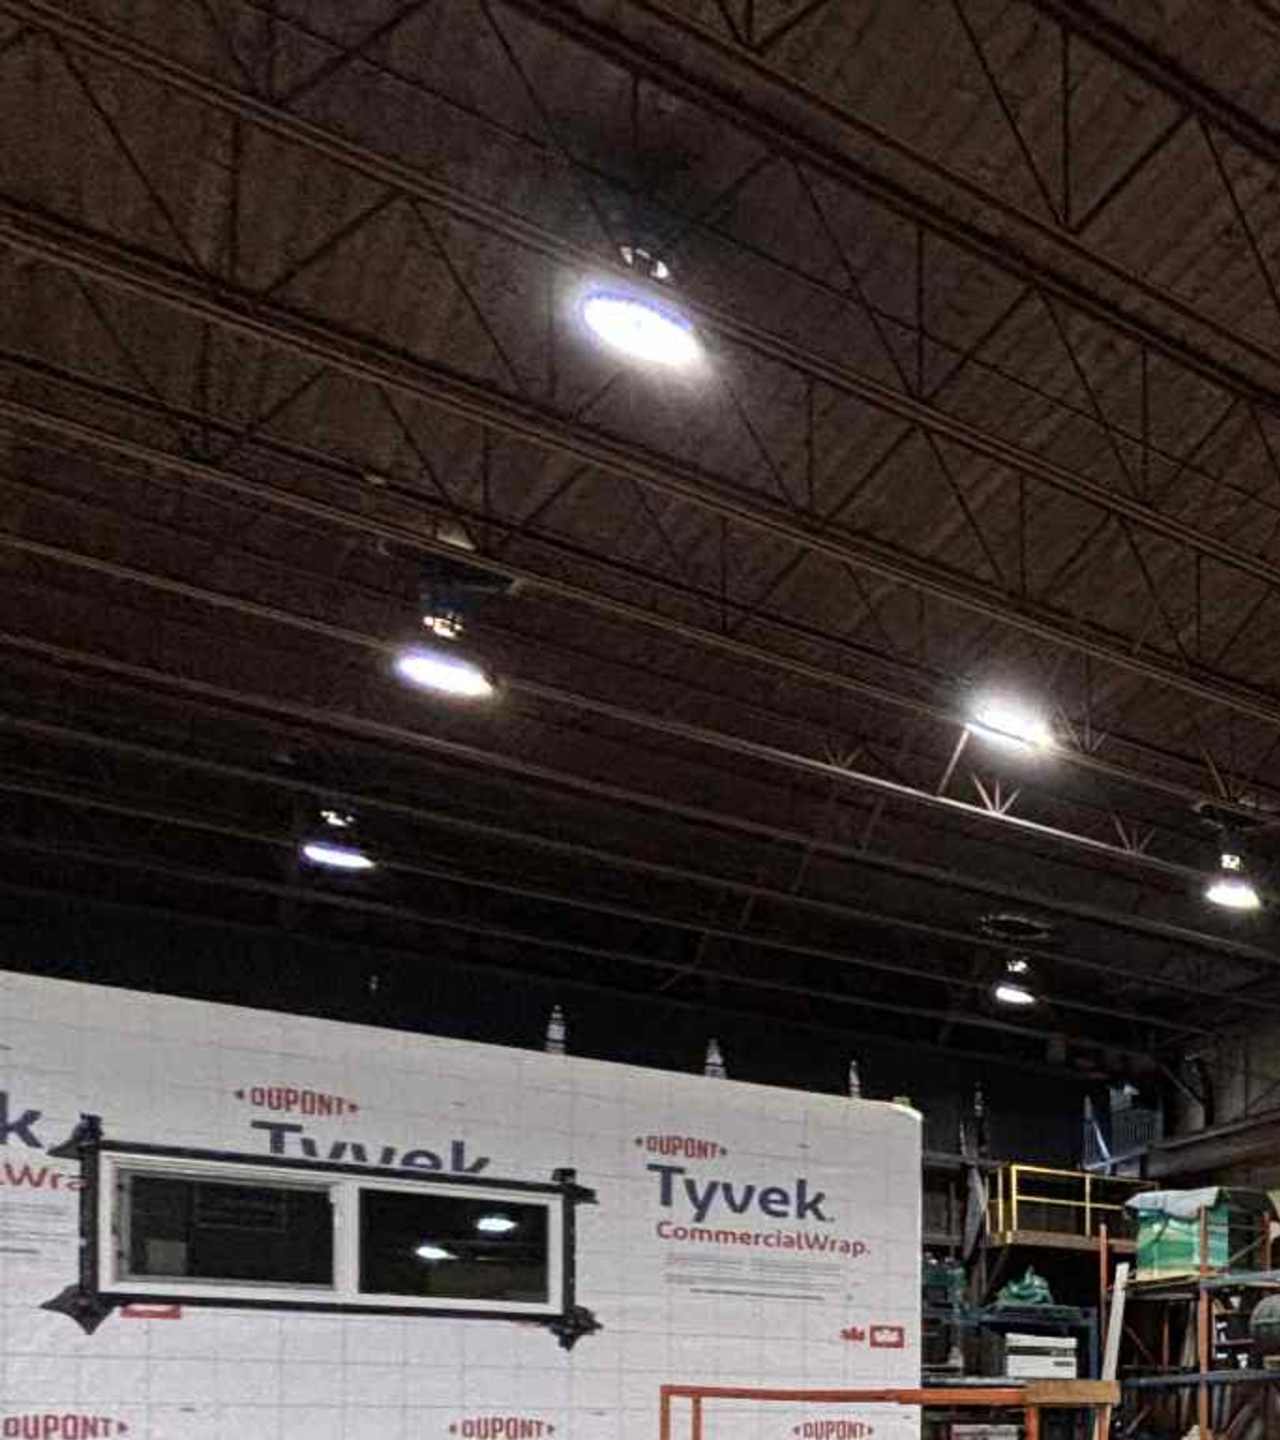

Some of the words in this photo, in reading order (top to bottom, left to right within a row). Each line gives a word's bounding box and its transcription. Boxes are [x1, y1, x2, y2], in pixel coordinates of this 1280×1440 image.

[250, 1086, 346, 1115] DUPONT
[646, 1135, 718, 1159] DUPONT
[646, 1163, 828, 1223] Tyvek
[2, 1414, 112, 1440] DUPONT
[461, 1417, 545, 1440] DUPONT
[803, 1421, 865, 1440] DUPONT
